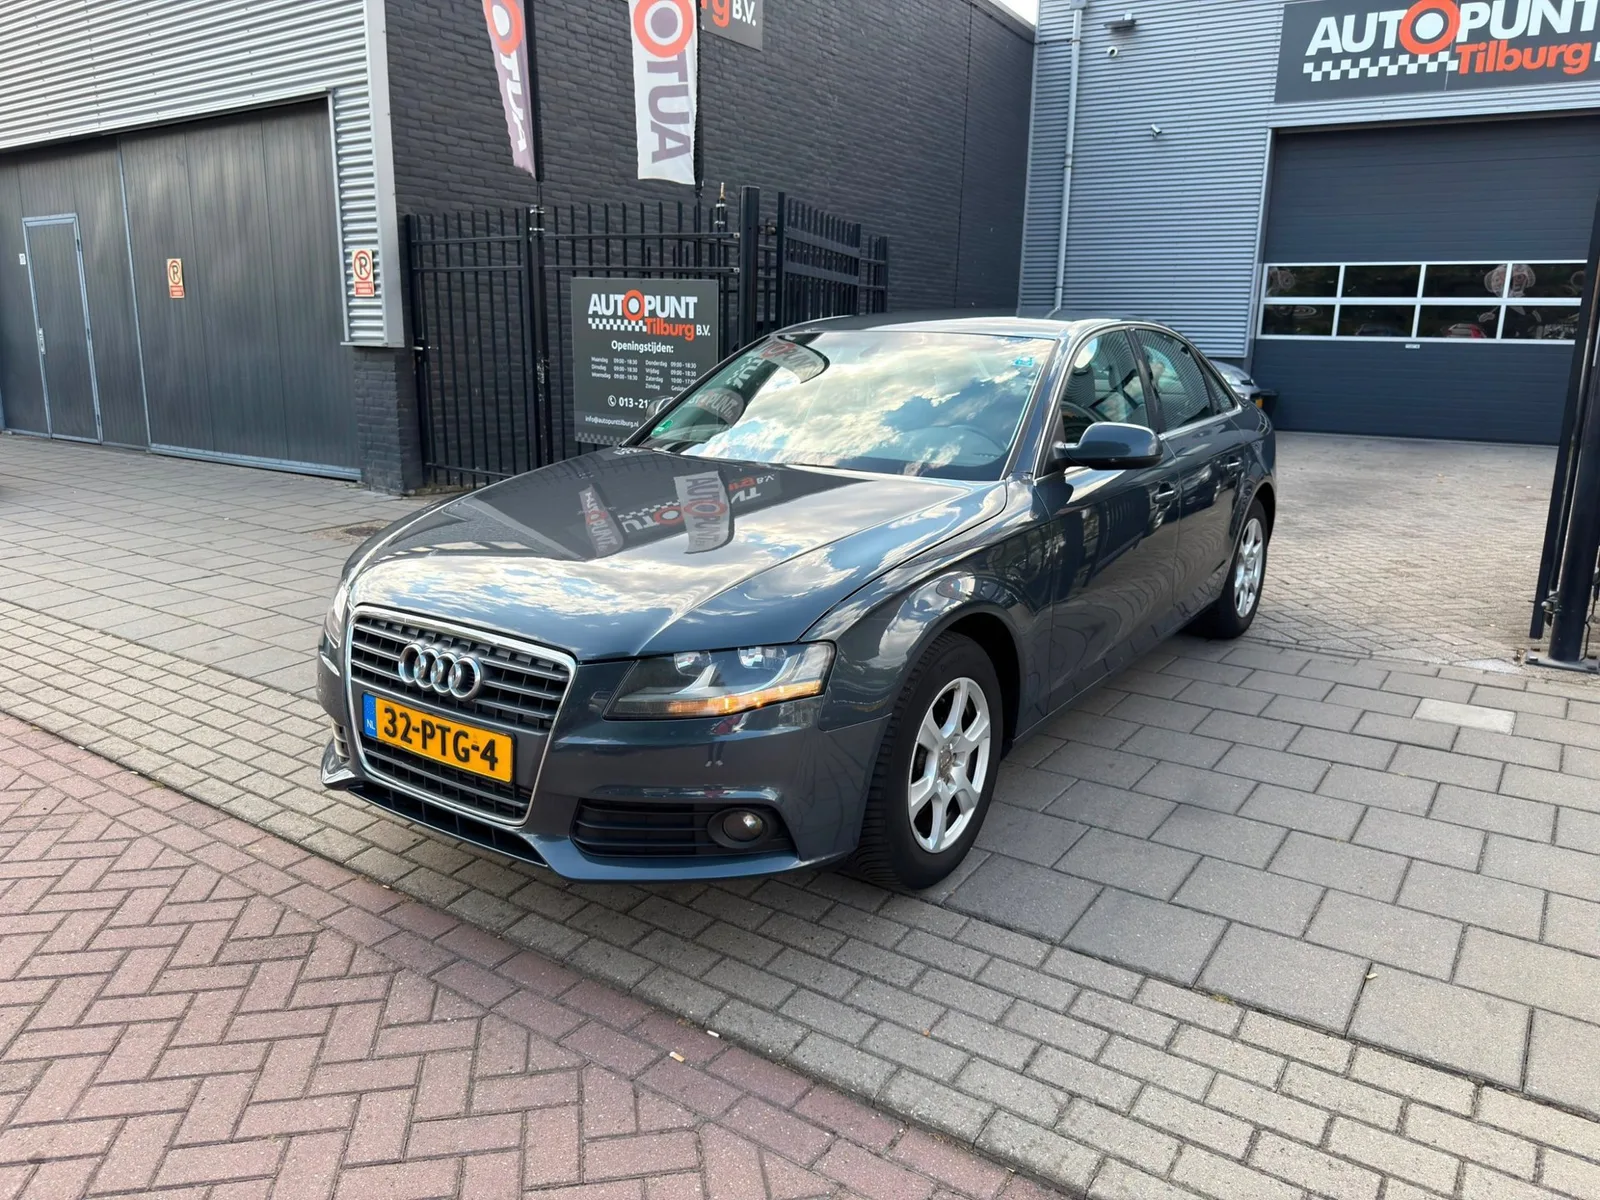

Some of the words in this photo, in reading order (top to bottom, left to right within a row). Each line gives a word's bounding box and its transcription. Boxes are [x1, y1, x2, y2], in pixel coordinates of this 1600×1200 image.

[1455, 39, 1592, 75] Tilburg
[588, 289, 698, 321] AUTOPUNT
[644, 318, 695, 341] Tilburg
[696, 324, 711, 336] B.V.
[611, 340, 674, 355] Openingstijden:
[366, 718, 376, 731] NL
[384, 706, 498, 771] 32-PTG-4
